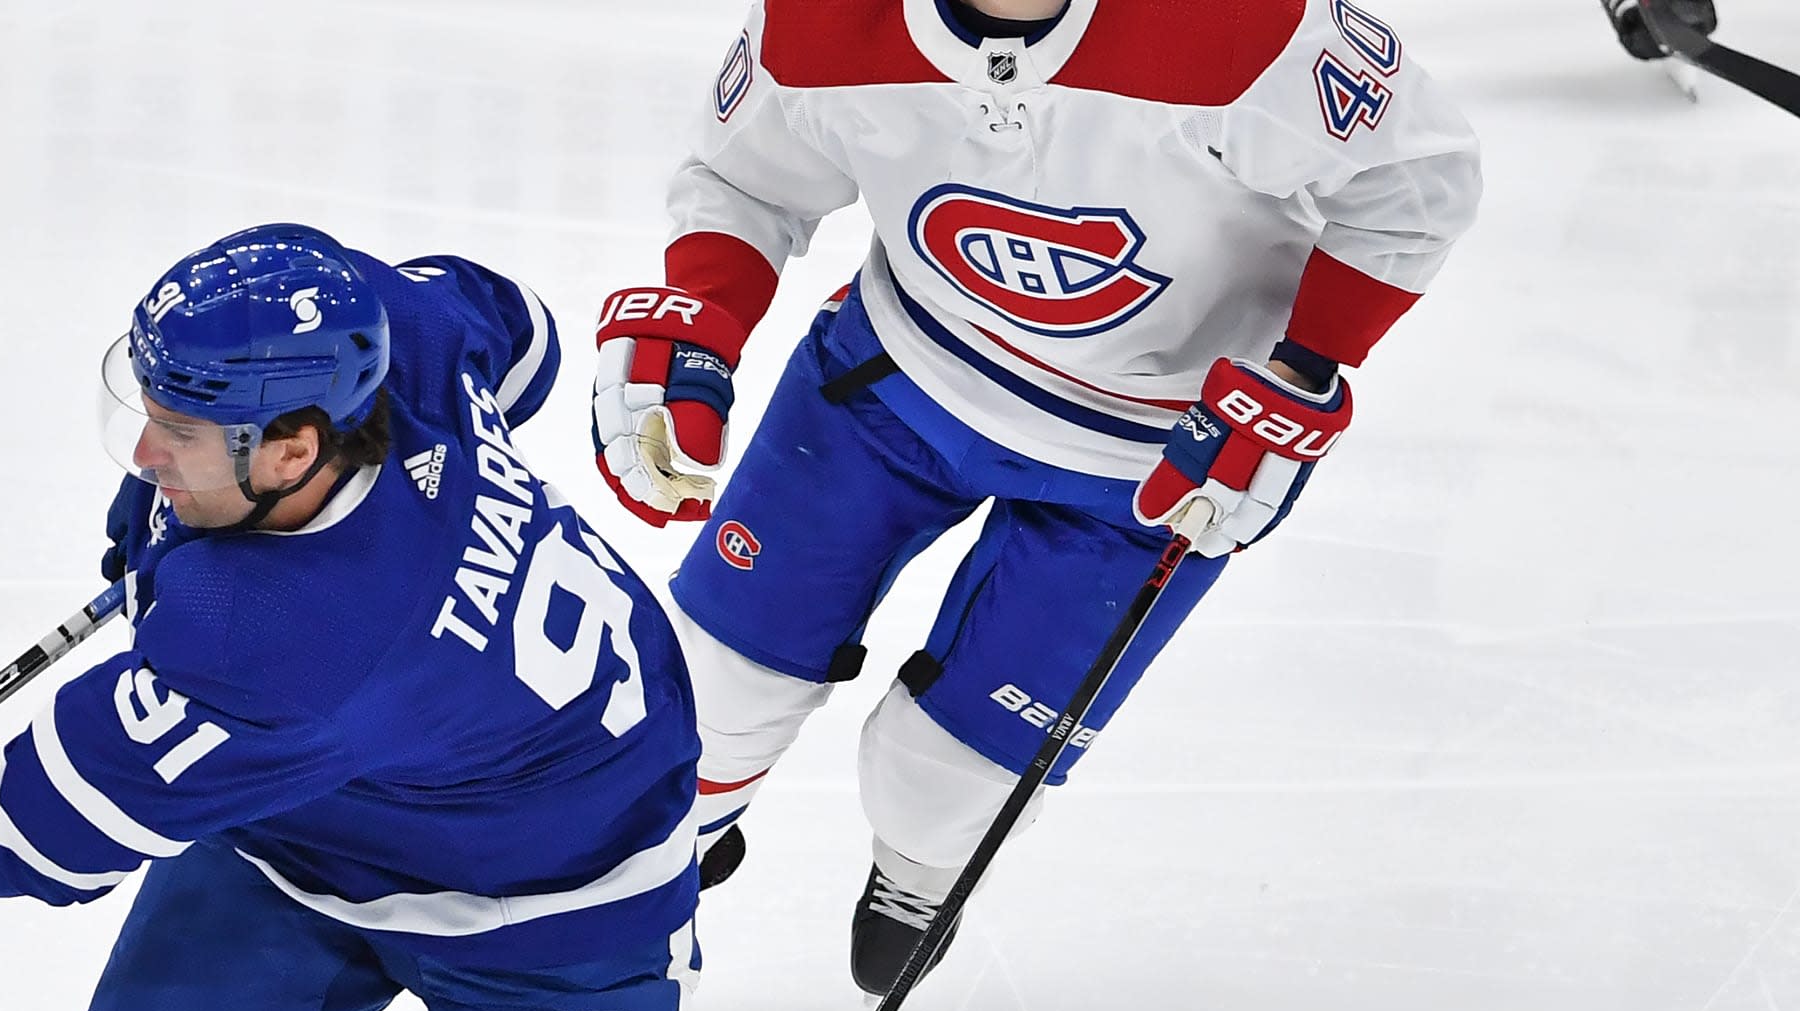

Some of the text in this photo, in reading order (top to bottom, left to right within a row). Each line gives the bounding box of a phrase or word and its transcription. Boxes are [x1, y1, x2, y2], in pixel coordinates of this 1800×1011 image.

[1312, 0, 1402, 142] 40
[147, 281, 187, 324] 91
[426, 443, 448, 500] adidas
[430, 373, 535, 653] TAVARES
[113, 667, 232, 785] 91
